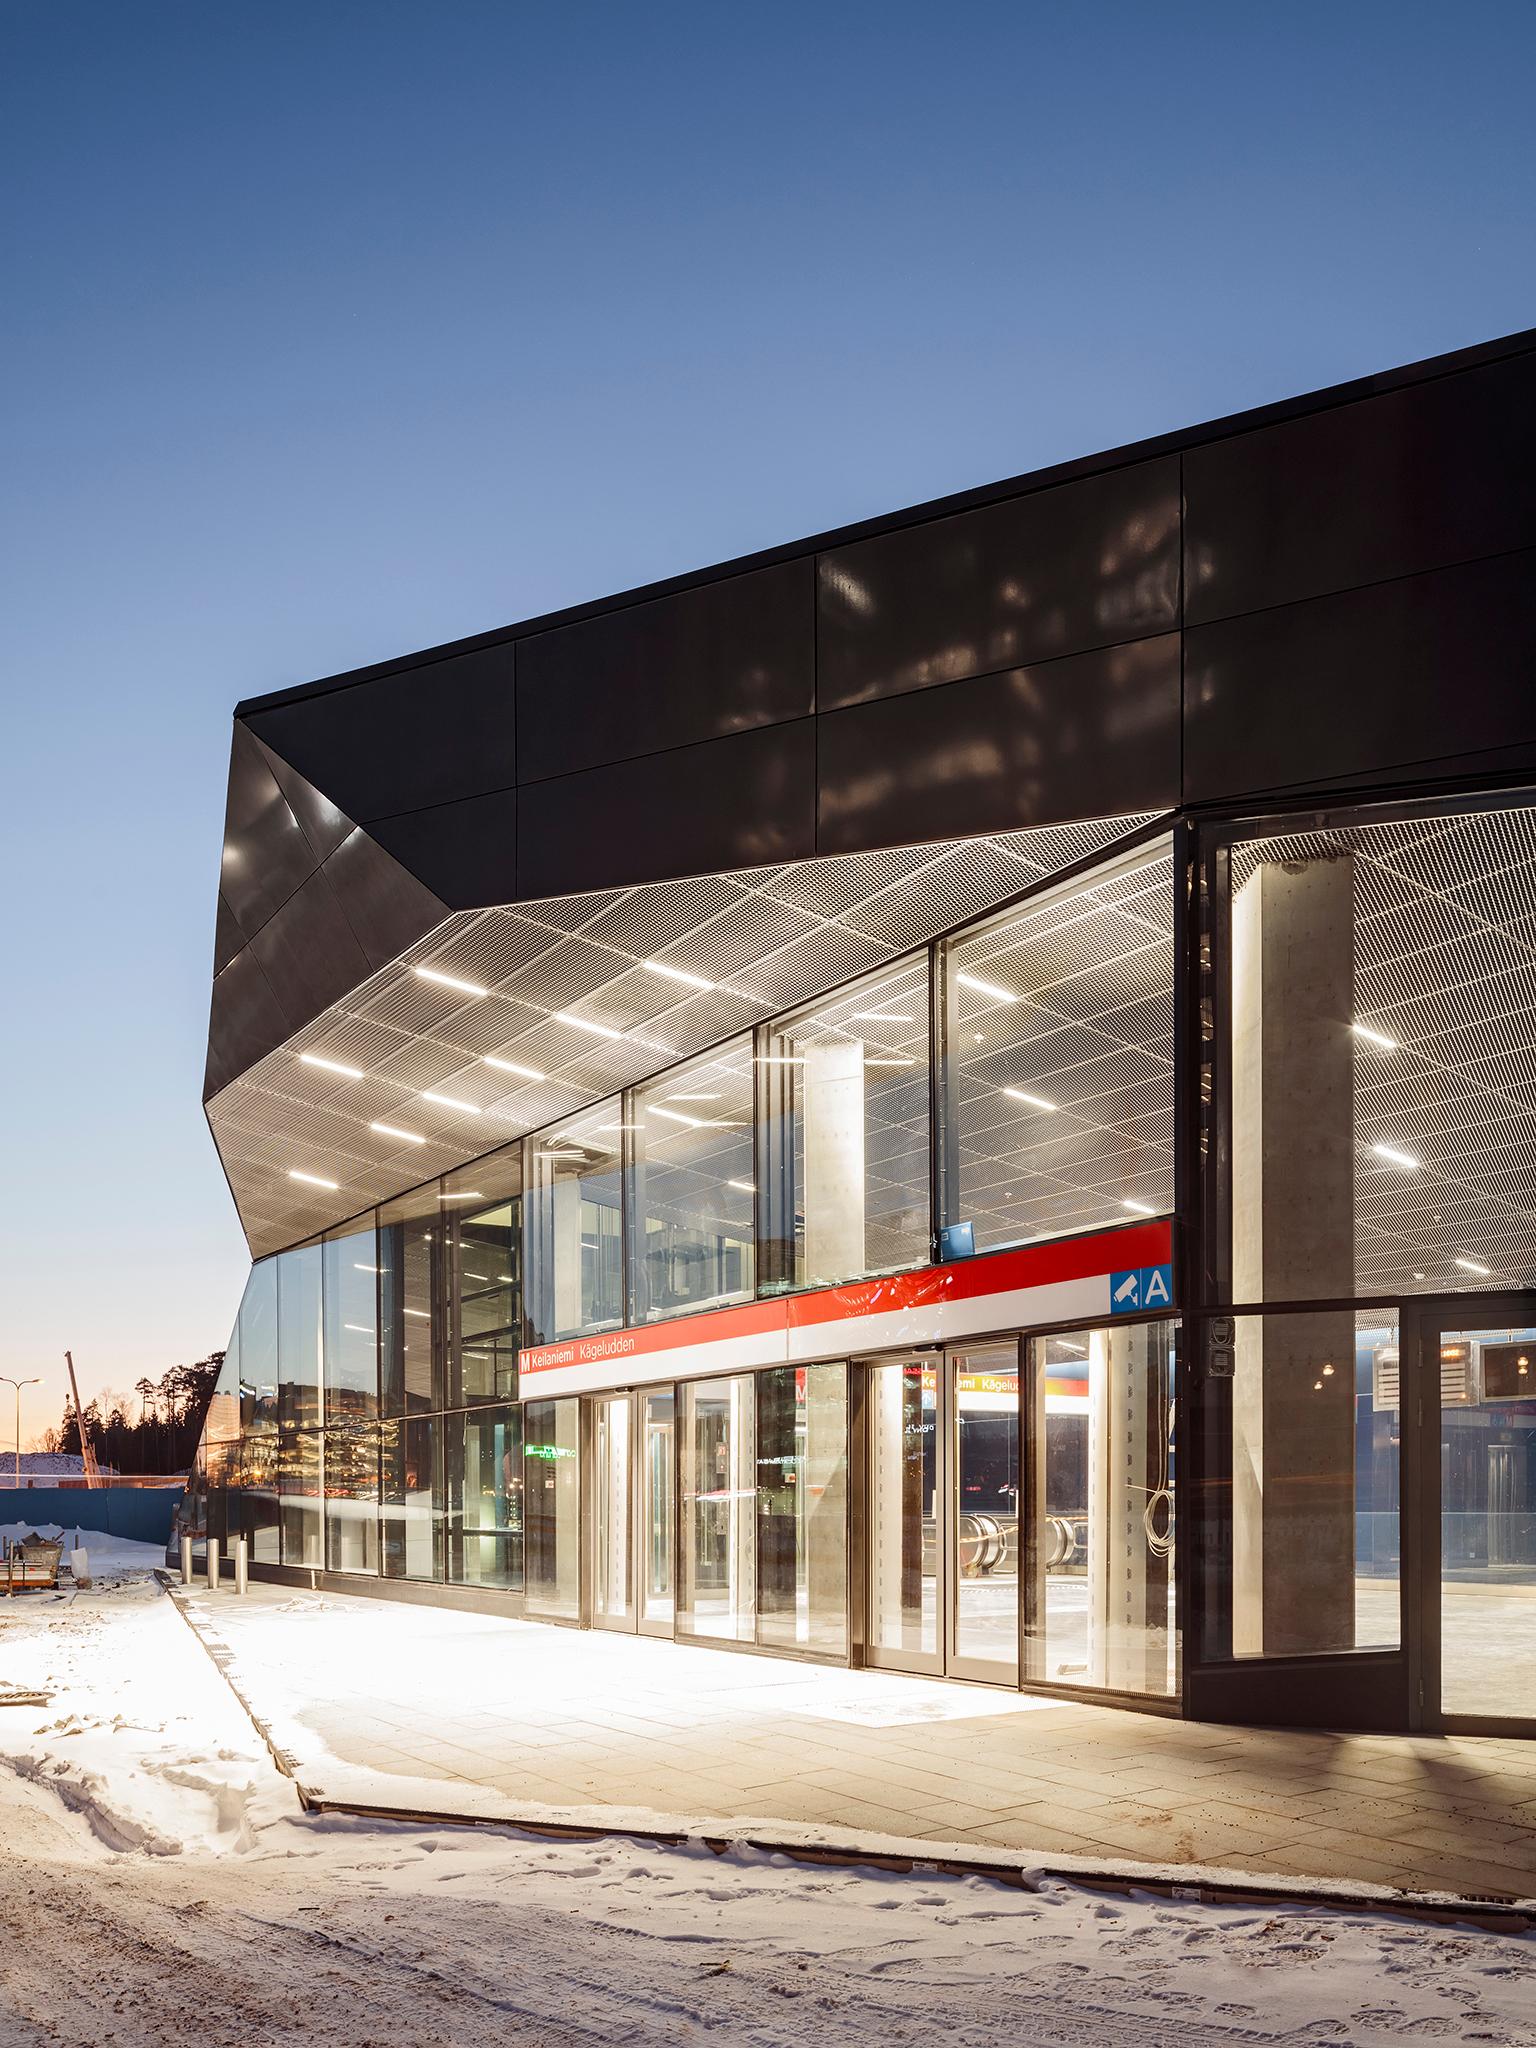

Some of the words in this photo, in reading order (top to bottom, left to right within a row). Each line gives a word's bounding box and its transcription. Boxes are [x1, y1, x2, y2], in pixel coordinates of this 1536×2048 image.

[1145, 1269, 1169, 1304] A
[521, 1352, 530, 1373] M
[532, 1346, 574, 1367] Keilaniemi
[580, 1336, 635, 1360] Kägeludden
